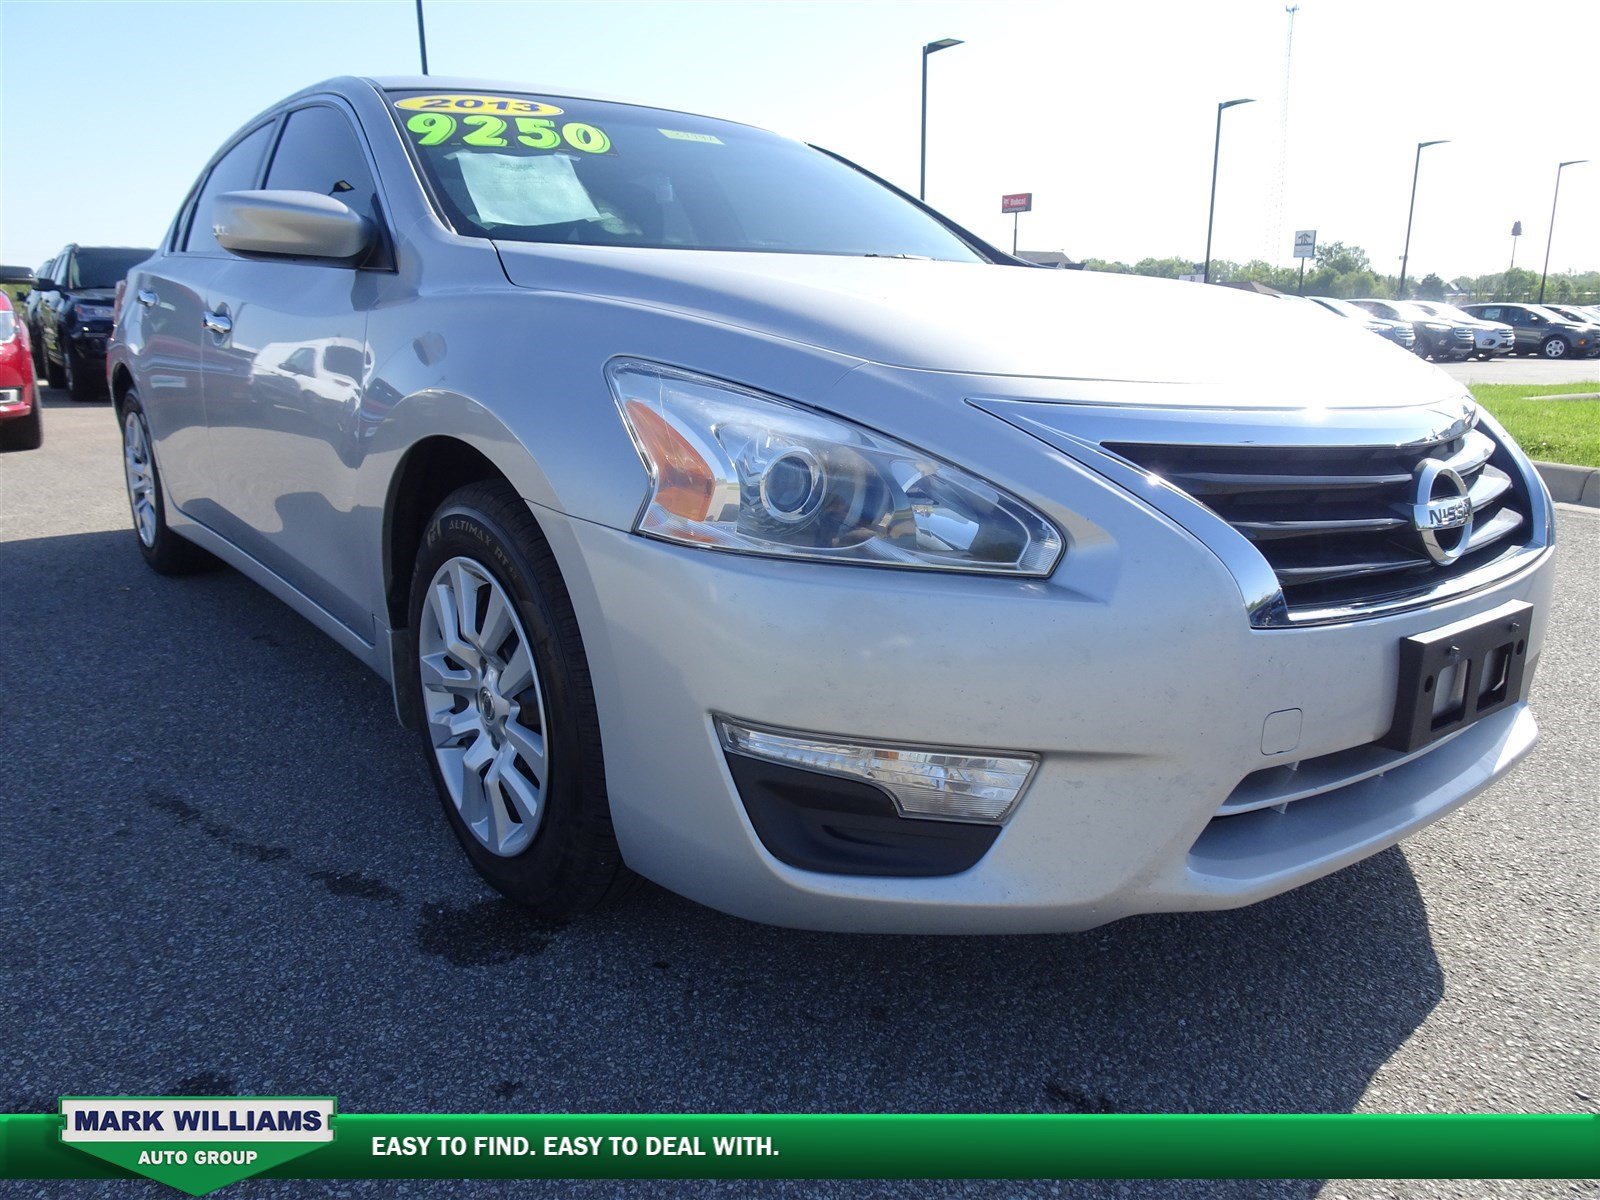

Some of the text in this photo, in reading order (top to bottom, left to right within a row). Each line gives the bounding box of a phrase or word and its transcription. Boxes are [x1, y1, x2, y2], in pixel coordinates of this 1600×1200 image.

[420, 98, 541, 113] 2013
[407, 112, 611, 153] 9250
[1429, 500, 1470, 525] NISS
[448, 519, 493, 547] ALTIMAX
